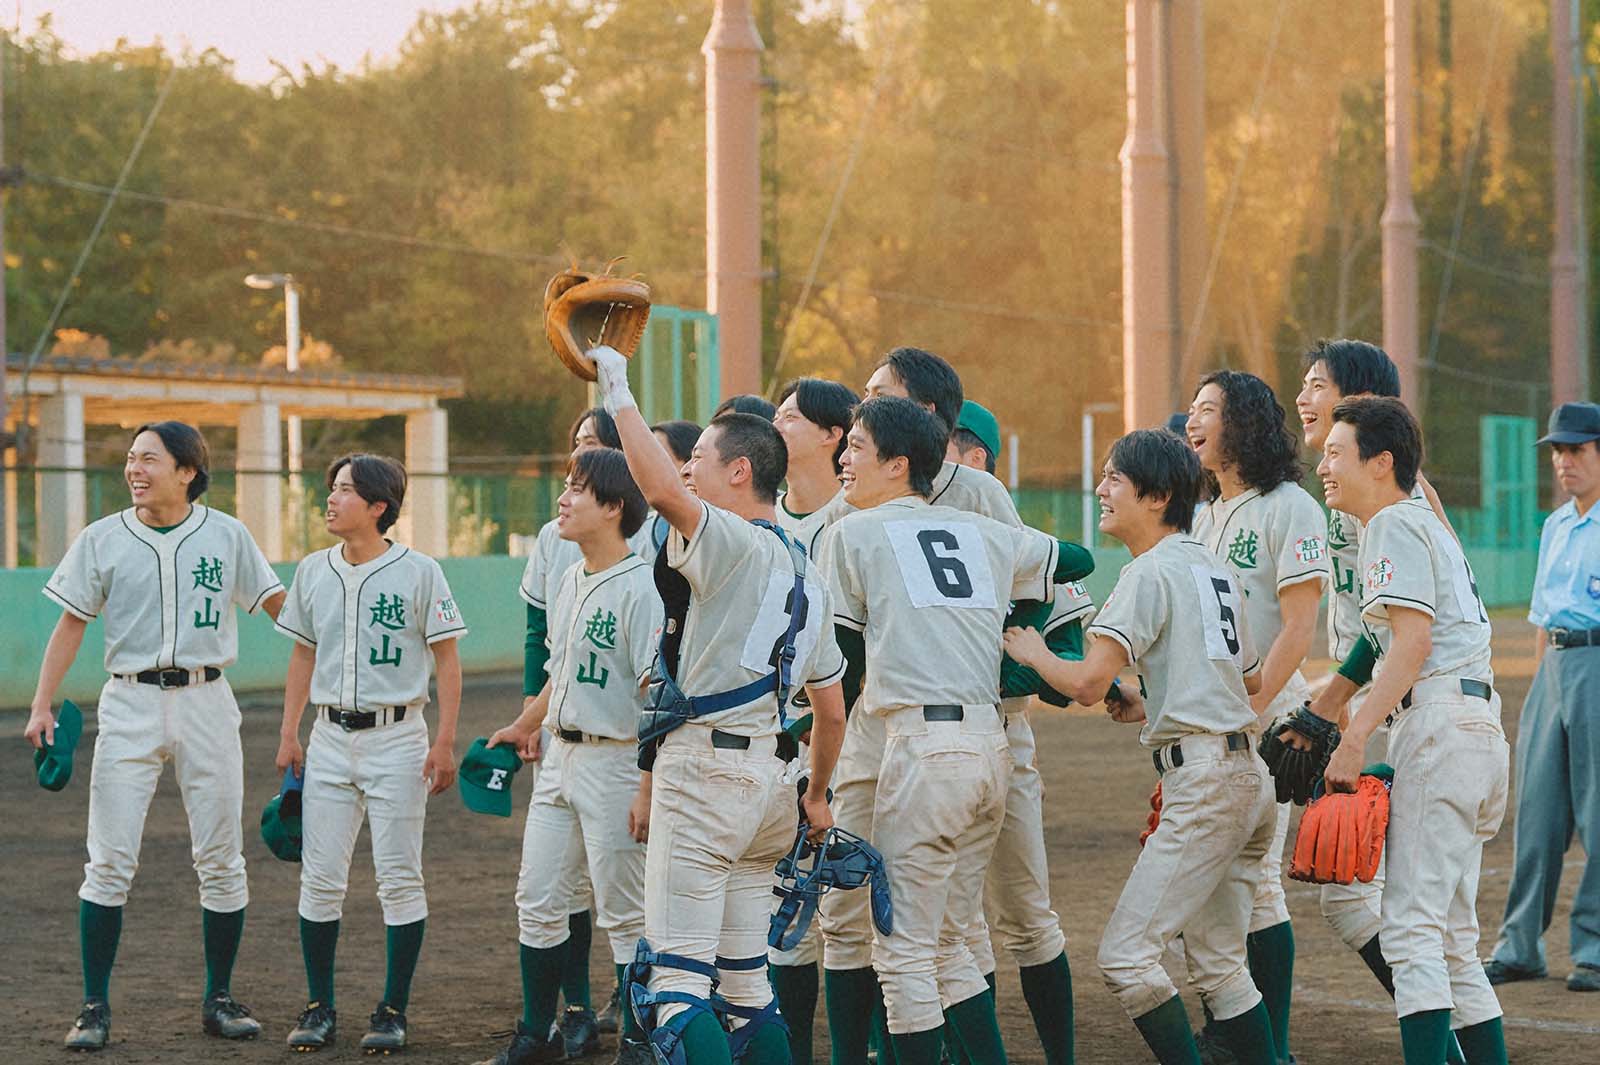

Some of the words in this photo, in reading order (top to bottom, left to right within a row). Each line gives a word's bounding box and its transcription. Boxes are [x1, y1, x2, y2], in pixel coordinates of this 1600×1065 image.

[191, 556, 223, 631] 越山
[916, 529, 974, 598] 6
[369, 592, 406, 667] 越山
[576, 606, 617, 689] 越山
[1210, 576, 1240, 656] 5
[487, 768, 508, 791] E
